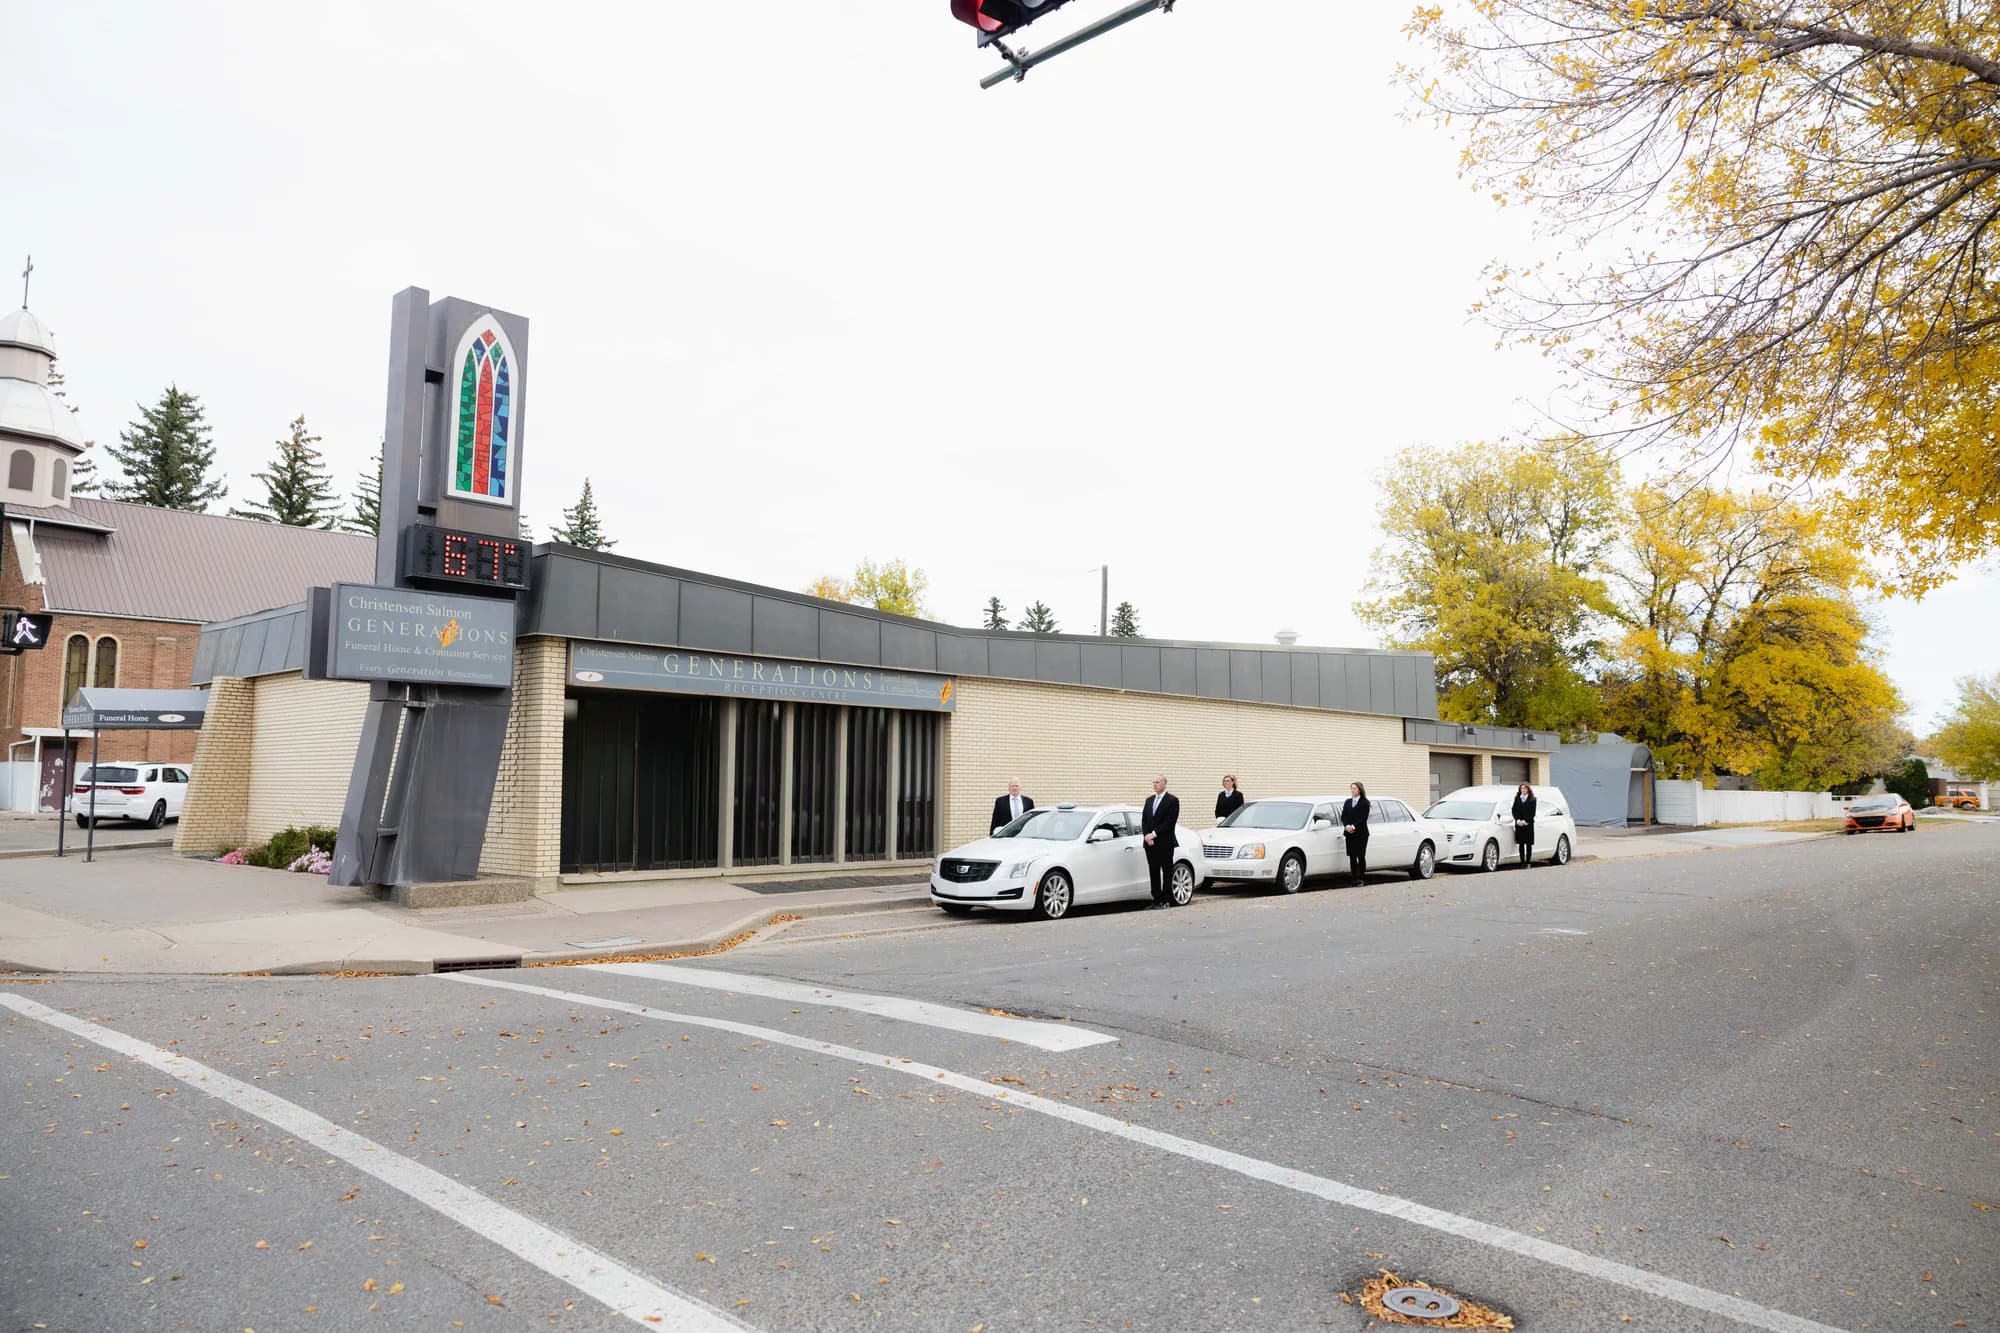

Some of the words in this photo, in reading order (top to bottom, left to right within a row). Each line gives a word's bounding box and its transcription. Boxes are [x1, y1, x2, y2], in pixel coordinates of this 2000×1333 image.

[349, 596, 423, 615] Christensen
[427, 604, 472, 620] Salmon
[348, 618, 508, 644] GENERATIONS
[345, 640, 380, 652] Funeral
[384, 644, 410, 654] Home
[415, 646, 422, 654] &
[472, 650, 508, 661] Services
[359, 663, 382, 673] Every
[387, 664, 444, 676] Generation
[580, 646, 627, 659] Christensen
[629, 651, 658, 662] Salmon
[664, 653, 872, 690] GENERATIONS
[725, 683, 796, 697] RECEPTION
[802, 688, 848, 700] CENTRE
[99, 714, 126, 722] Funeral
[128, 714, 149, 722] Home
